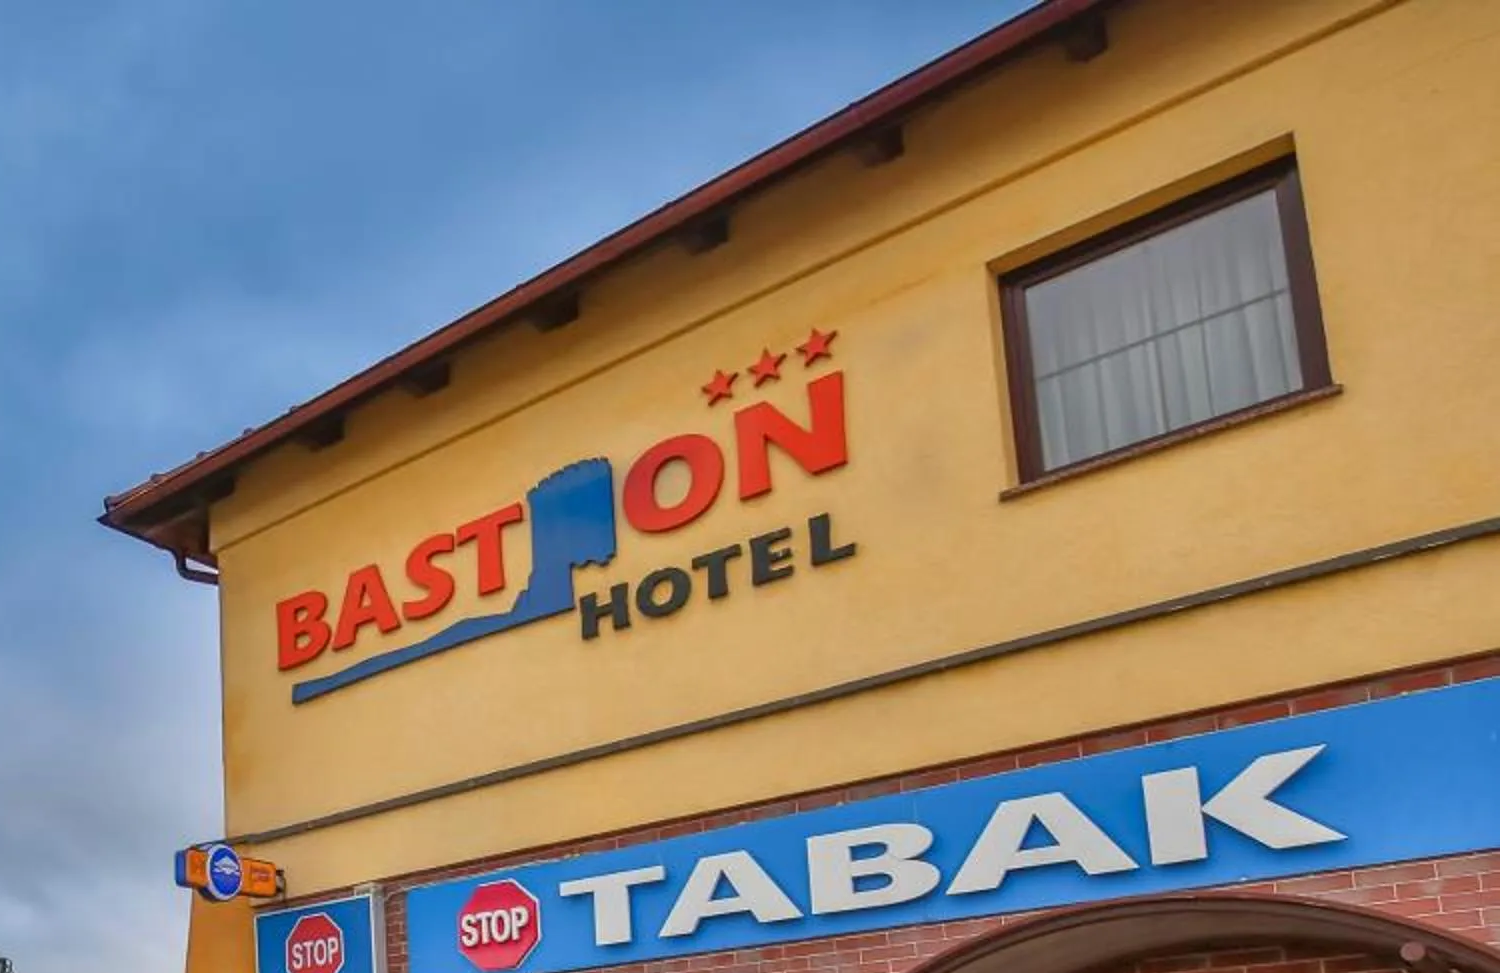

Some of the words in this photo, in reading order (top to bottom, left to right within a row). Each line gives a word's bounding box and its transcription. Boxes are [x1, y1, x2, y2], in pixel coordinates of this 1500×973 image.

[579, 512, 857, 640] HOTEL
[459, 905, 529, 949] STOP
[558, 743, 1349, 947] TABAK
[291, 937, 339, 969] STOP
